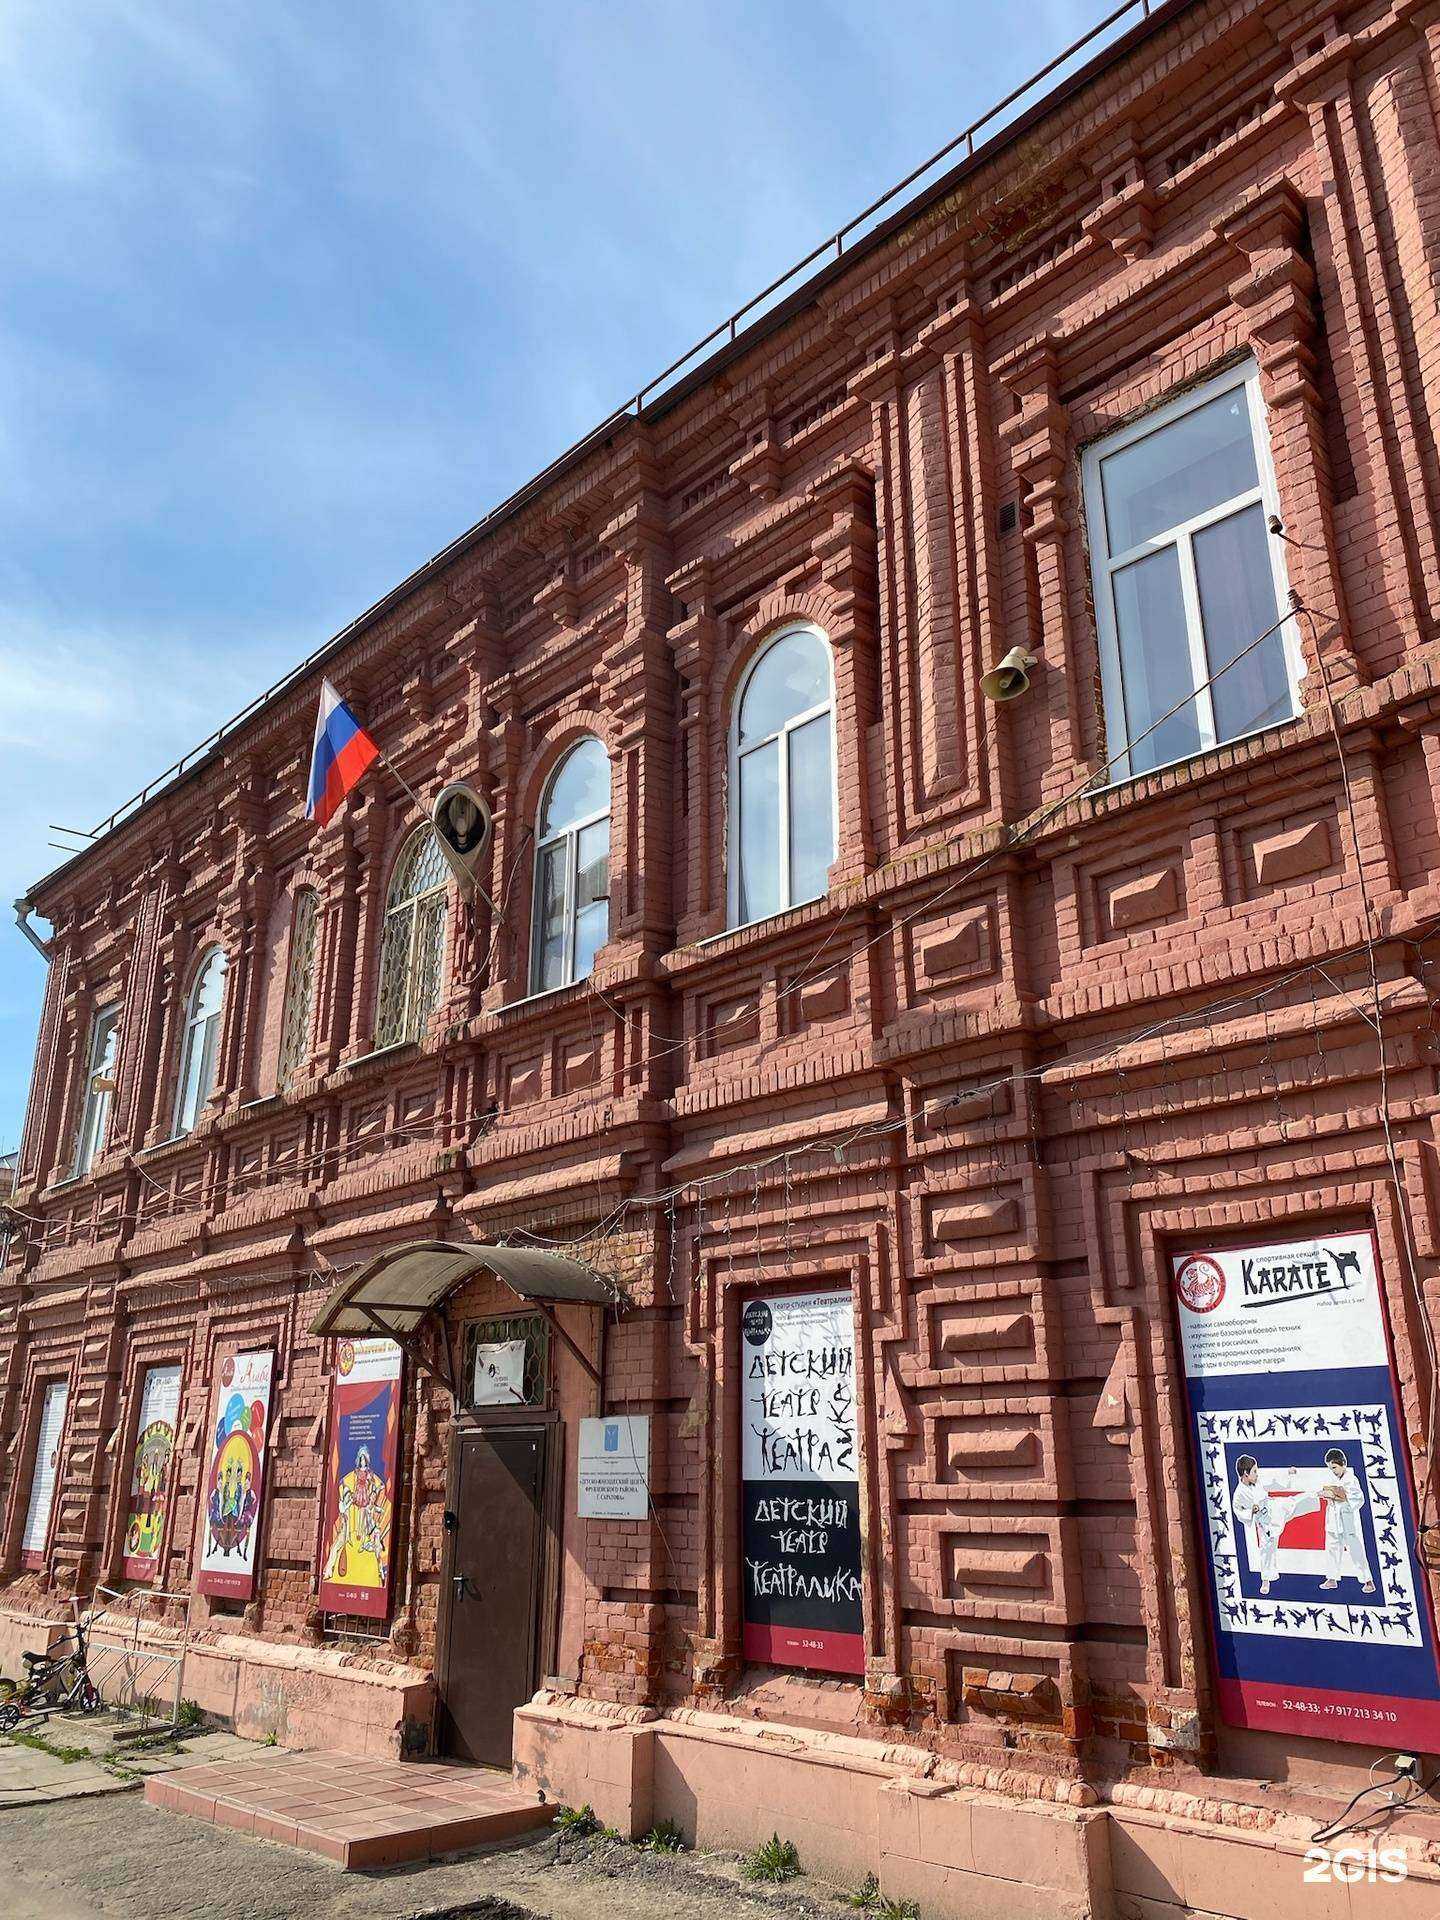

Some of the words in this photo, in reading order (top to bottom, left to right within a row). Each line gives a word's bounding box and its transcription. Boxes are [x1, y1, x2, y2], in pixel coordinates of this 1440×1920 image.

[1256, 1254, 1295, 1263] спортивная
[1296, 1250, 1320, 1259] секция
[1242, 1259, 1331, 1295] KARATE
[1190, 1322, 1212, 1330] навыки
[1214, 1318, 1258, 1328] самообороны
[1191, 1332, 1219, 1340] изучение
[1220, 1328, 1246, 1336] базовой
[1252, 1326, 1278, 1334] боевой
[1222, 1339, 1258, 1348] российских
[1199, 1350, 1250, 1360] международных
[750, 1388, 820, 1418] ТЕАТР
[770, 1528, 828, 1554] ТЕАТР
[745, 1557, 862, 1602] ТЕАТРАЛИКА
[1282, 1700, 1321, 1714] 52-48-33;
[1324, 1705, 1334, 1715] +7
[1336, 1706, 1352, 1717] 917
[1353, 1708, 1370, 1719] 213
[1372, 1710, 1384, 1720] 34
[1385, 1712, 1397, 1722] 10
